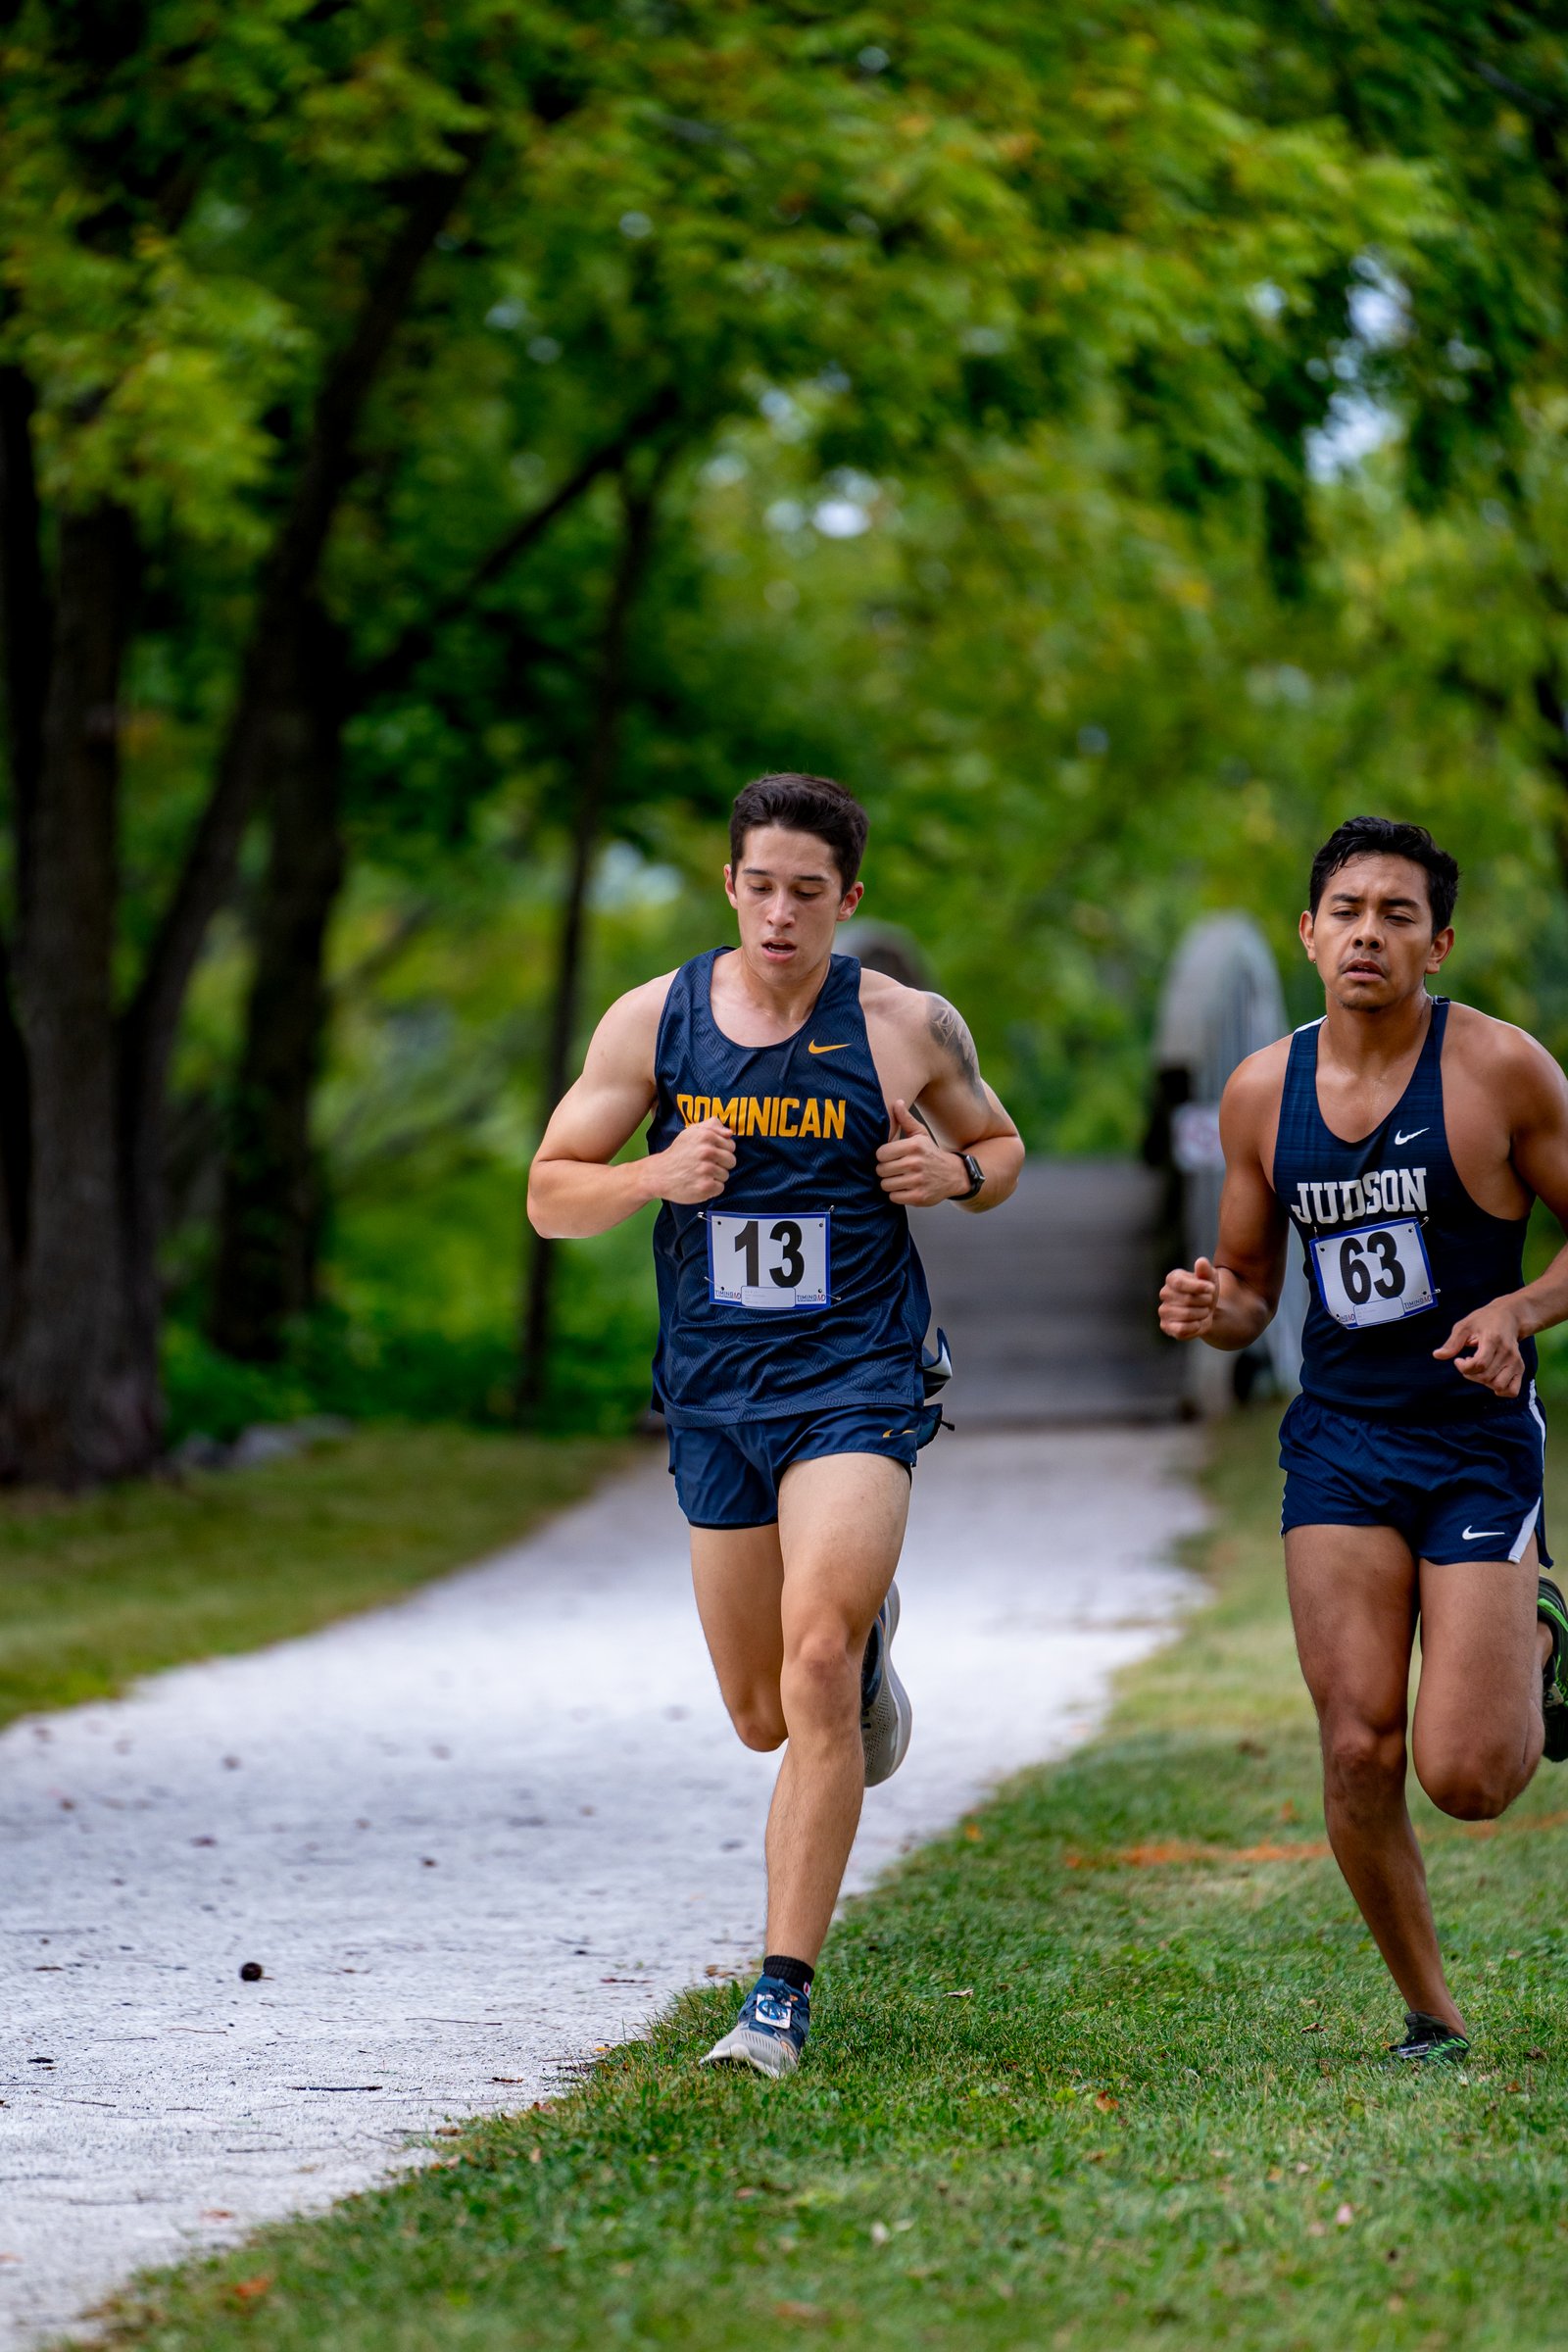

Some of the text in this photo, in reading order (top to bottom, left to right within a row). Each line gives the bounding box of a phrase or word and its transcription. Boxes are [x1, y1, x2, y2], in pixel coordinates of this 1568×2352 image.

[676, 1094, 846, 1140] DOMINICAN
[1290, 1167, 1428, 1225] JUDSON
[734, 1220, 805, 1289] 13
[1339, 1231, 1406, 1304] 63
